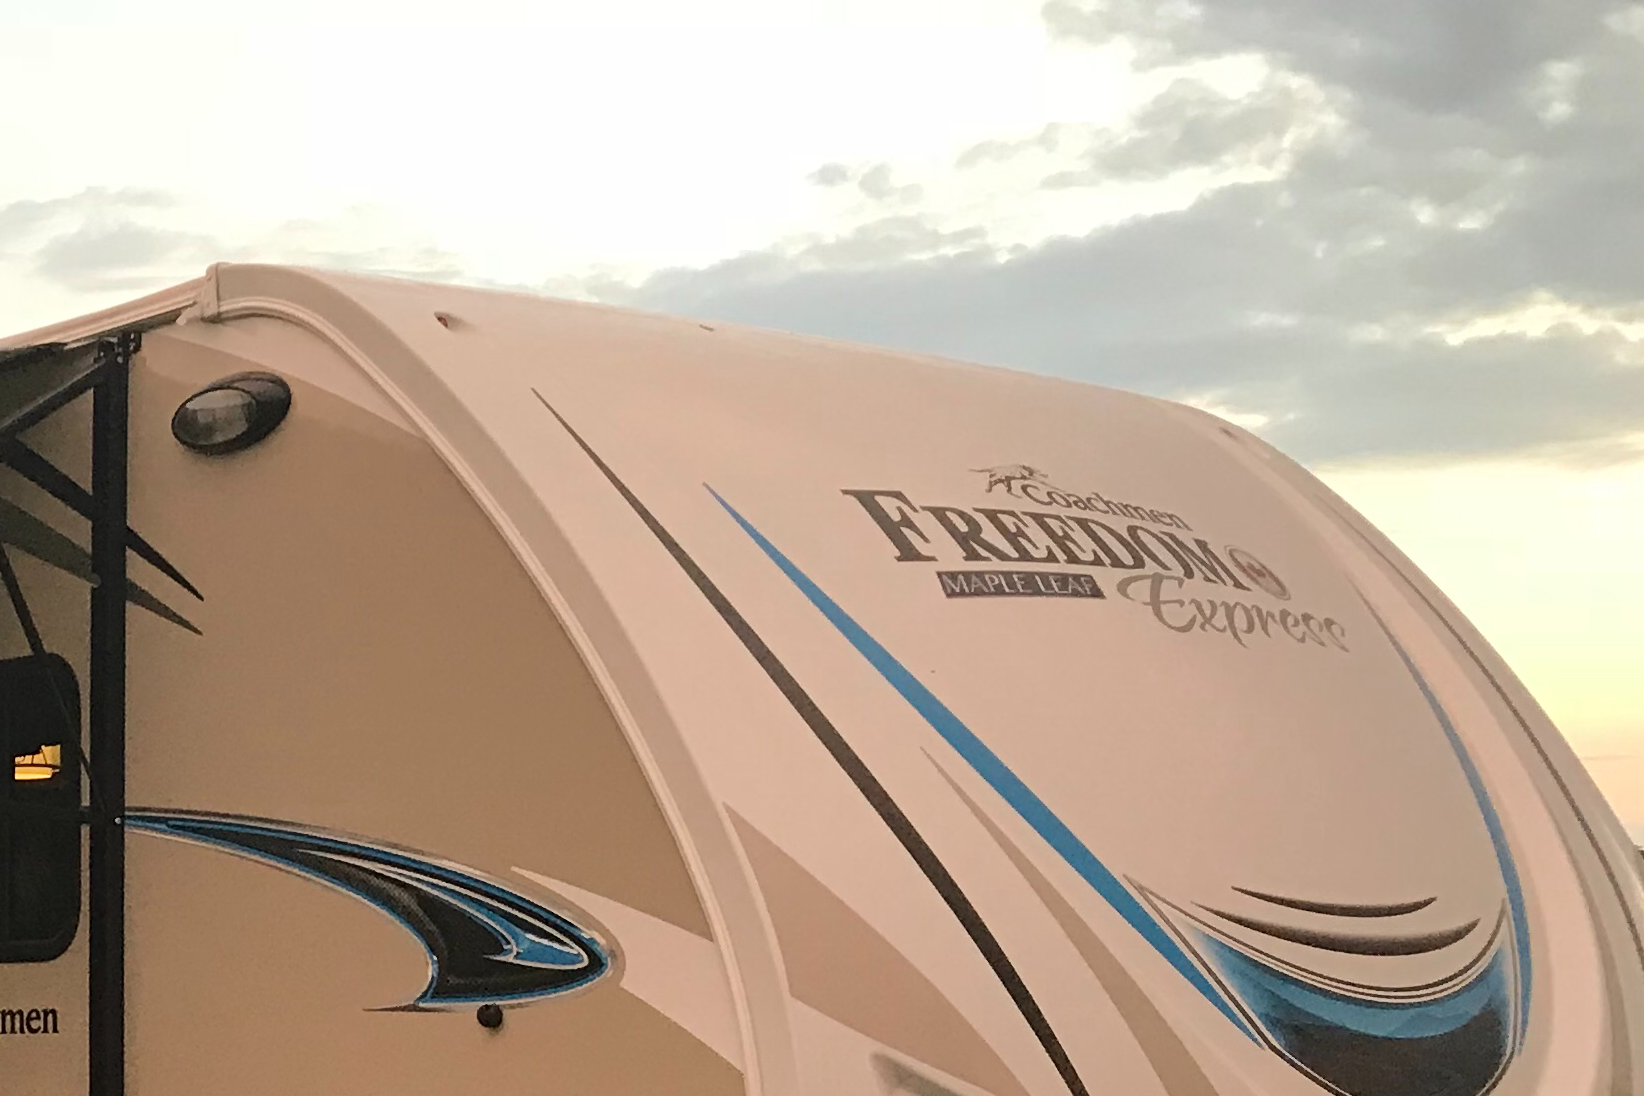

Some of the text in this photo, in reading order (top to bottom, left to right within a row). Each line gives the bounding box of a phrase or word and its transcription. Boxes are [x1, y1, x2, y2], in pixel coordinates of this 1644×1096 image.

[1021, 482, 1194, 532] Coachmen
[840, 488, 1253, 592] FREEDOM
[943, 572, 1096, 597] MAPLE LEAF
[1117, 572, 1350, 653] Express
